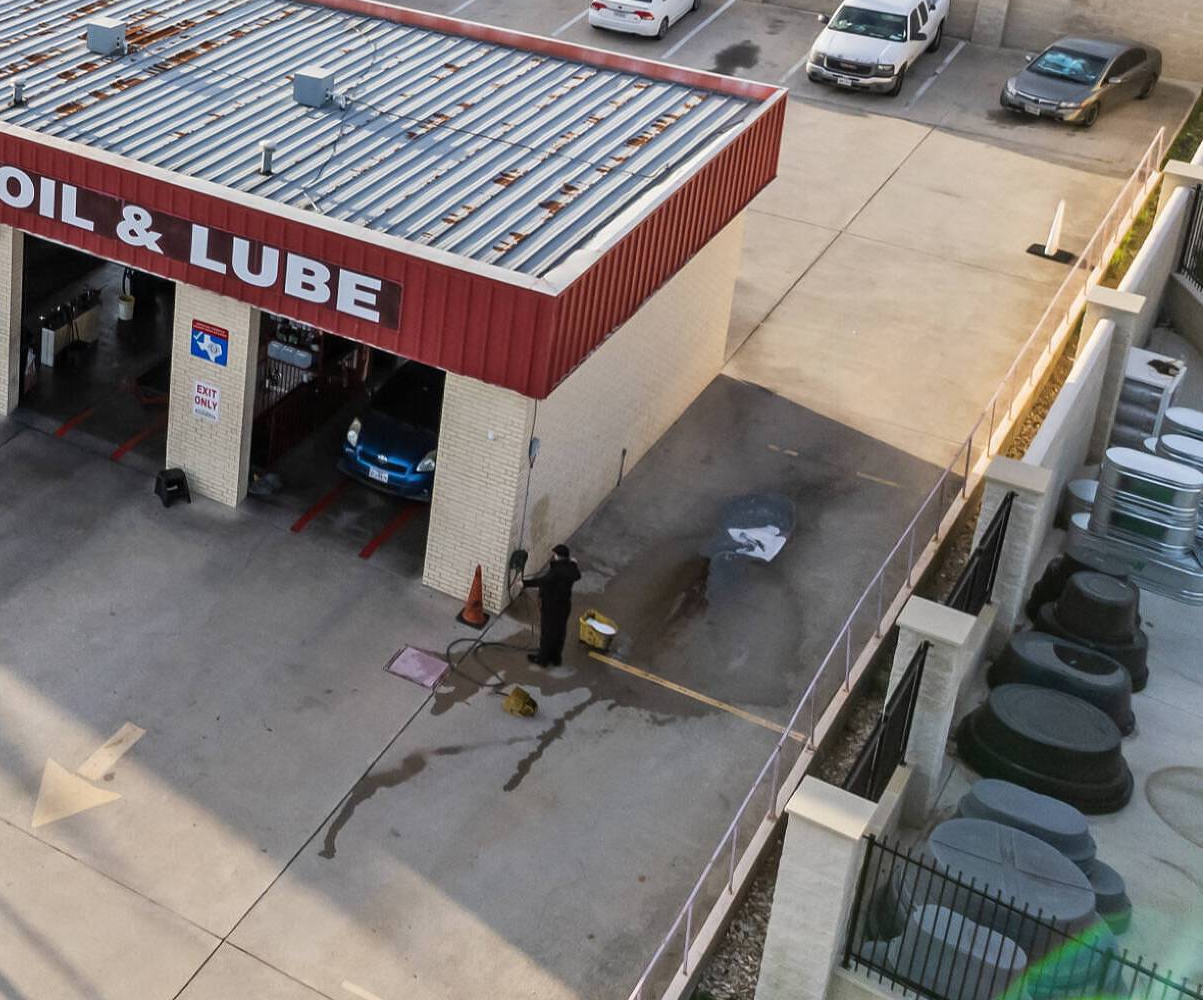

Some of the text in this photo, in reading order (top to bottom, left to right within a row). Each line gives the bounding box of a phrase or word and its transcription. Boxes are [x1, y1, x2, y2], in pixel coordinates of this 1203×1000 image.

[116, 204, 165, 256] &
[189, 223, 382, 324] LUBE
[196, 384, 217, 399] EXIT
[194, 395, 218, 411] ONLY
